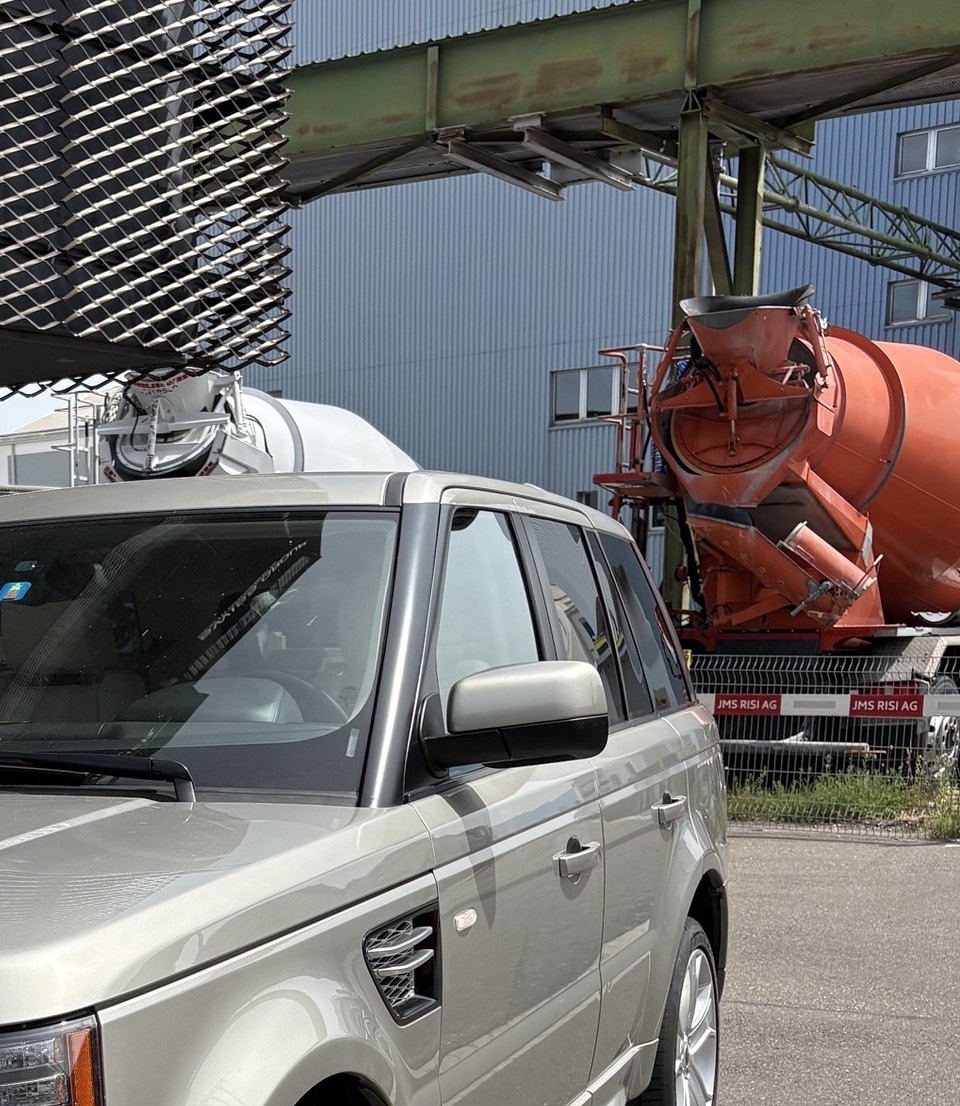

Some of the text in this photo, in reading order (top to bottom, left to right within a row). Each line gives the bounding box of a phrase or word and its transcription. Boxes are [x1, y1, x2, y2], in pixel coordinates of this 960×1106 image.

[717, 699, 777, 710] JMS RISI AG
[852, 700, 918, 711] JMS RISI AG
